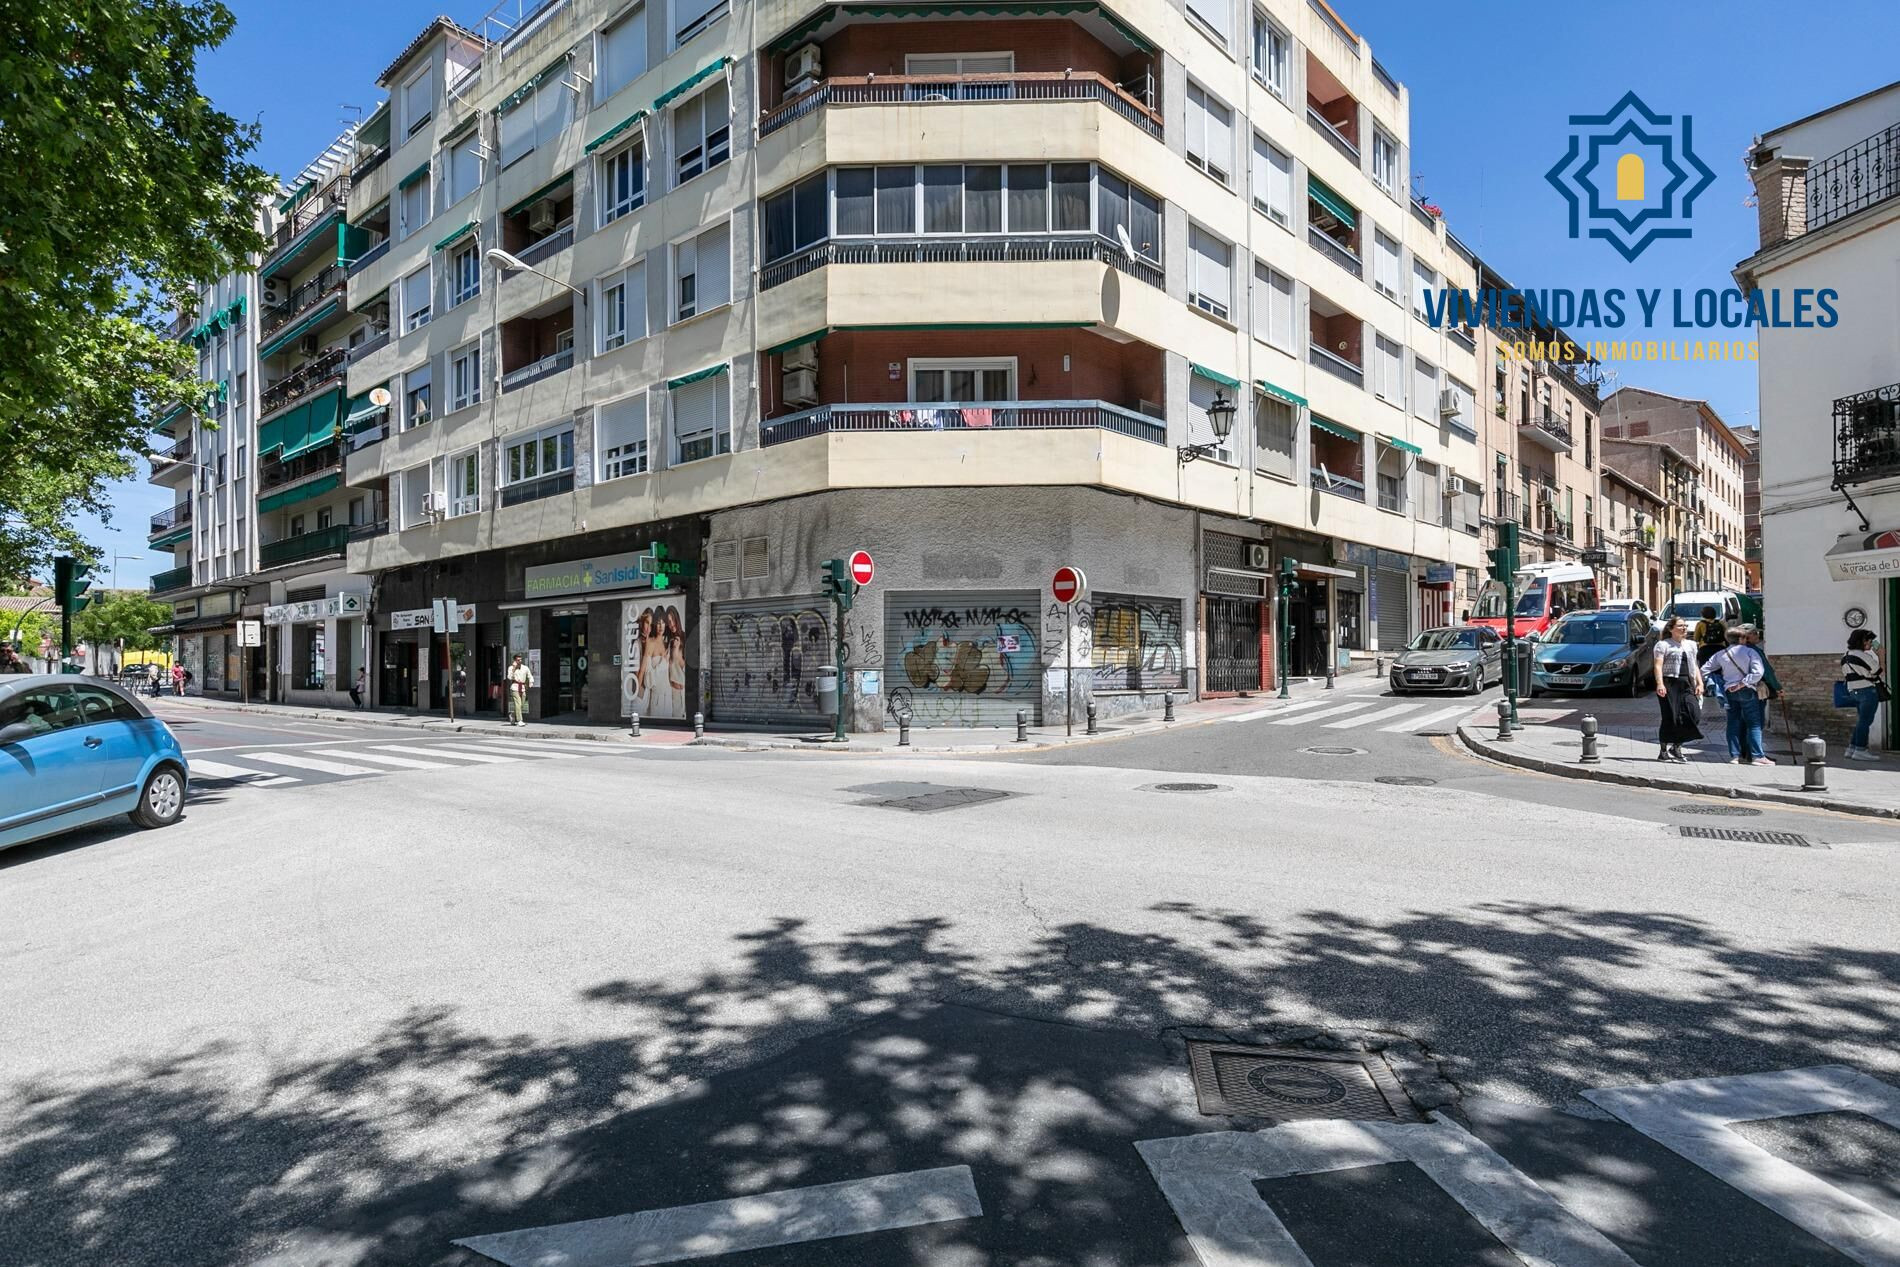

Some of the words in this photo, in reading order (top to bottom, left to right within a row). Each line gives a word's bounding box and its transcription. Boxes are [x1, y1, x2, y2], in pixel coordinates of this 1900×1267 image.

[1850, 564, 1877, 575] gracia
[1879, 560, 1890, 570] de
[527, 575, 580, 592] FARMACIA
